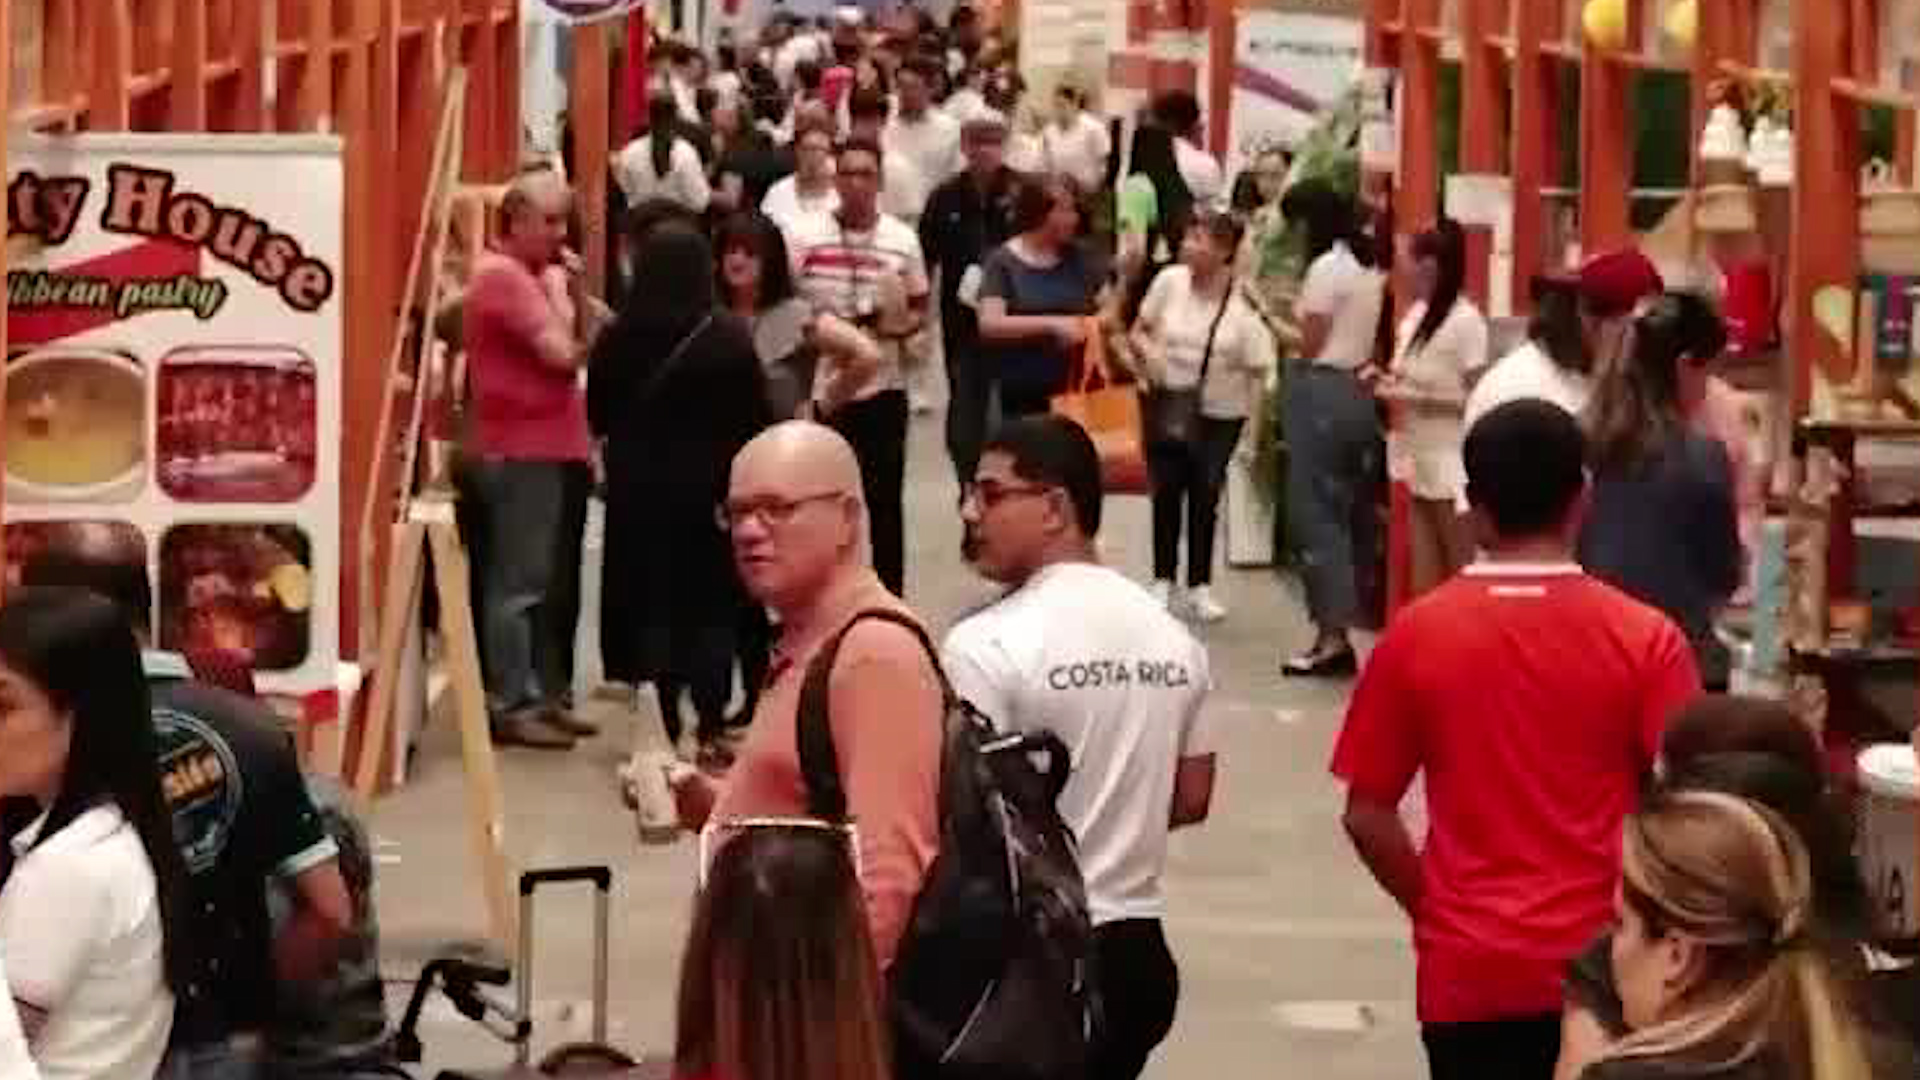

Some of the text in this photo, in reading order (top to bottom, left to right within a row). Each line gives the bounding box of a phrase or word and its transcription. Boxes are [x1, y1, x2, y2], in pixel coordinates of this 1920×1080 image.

[101, 163, 333, 311] House
[114, 275, 228, 319] pastry
[1048, 659, 1190, 691] COSTA RICA
